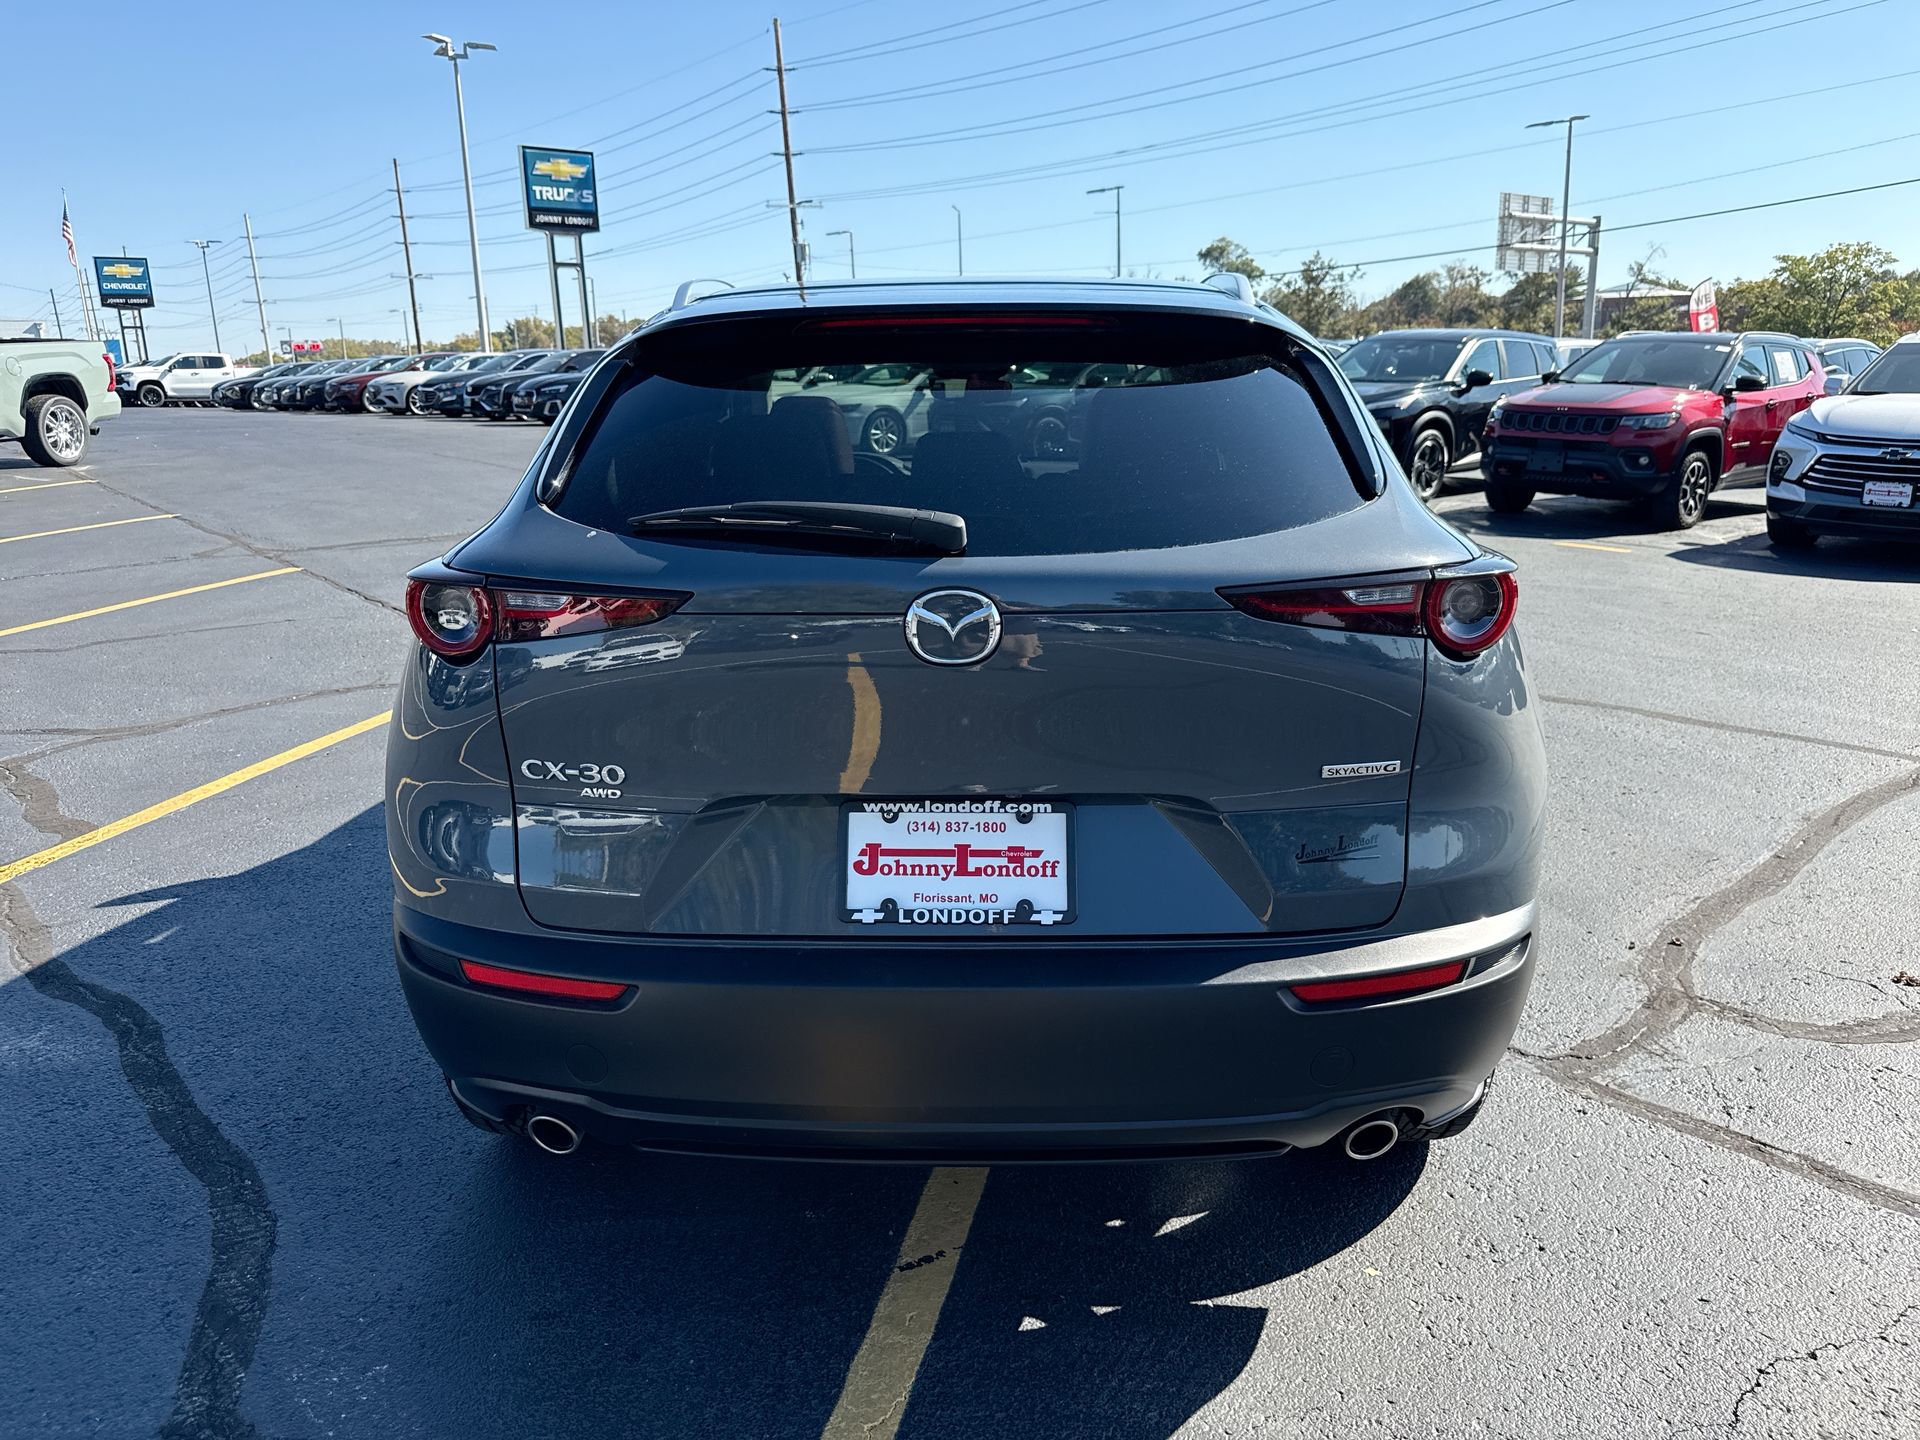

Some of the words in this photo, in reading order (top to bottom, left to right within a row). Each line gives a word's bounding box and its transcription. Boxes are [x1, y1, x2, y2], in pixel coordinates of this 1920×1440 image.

[535, 214, 563, 224] JOHNNY
[565, 216, 594, 226] LONDOFF
[102, 282, 147, 290] CHEVROLET
[1694, 293, 1712, 307] WE
[520, 759, 626, 785] CX-30
[580, 787, 622, 799] AWD
[863, 800, 1052, 813] www.londoff.com
[906, 821, 941, 835] (314)
[945, 821, 1007, 833] 837-1800
[1000, 850, 1033, 858] Chevrolet
[1295, 843, 1336, 861] Johnny
[1337, 834, 1380, 852] Londoff
[852, 843, 955, 881] Johnny
[953, 843, 1060, 878] Londoff
[913, 893, 975, 905] Florissant,
[979, 893, 999, 904] MO
[899, 908, 1017, 924] LONDOFF
